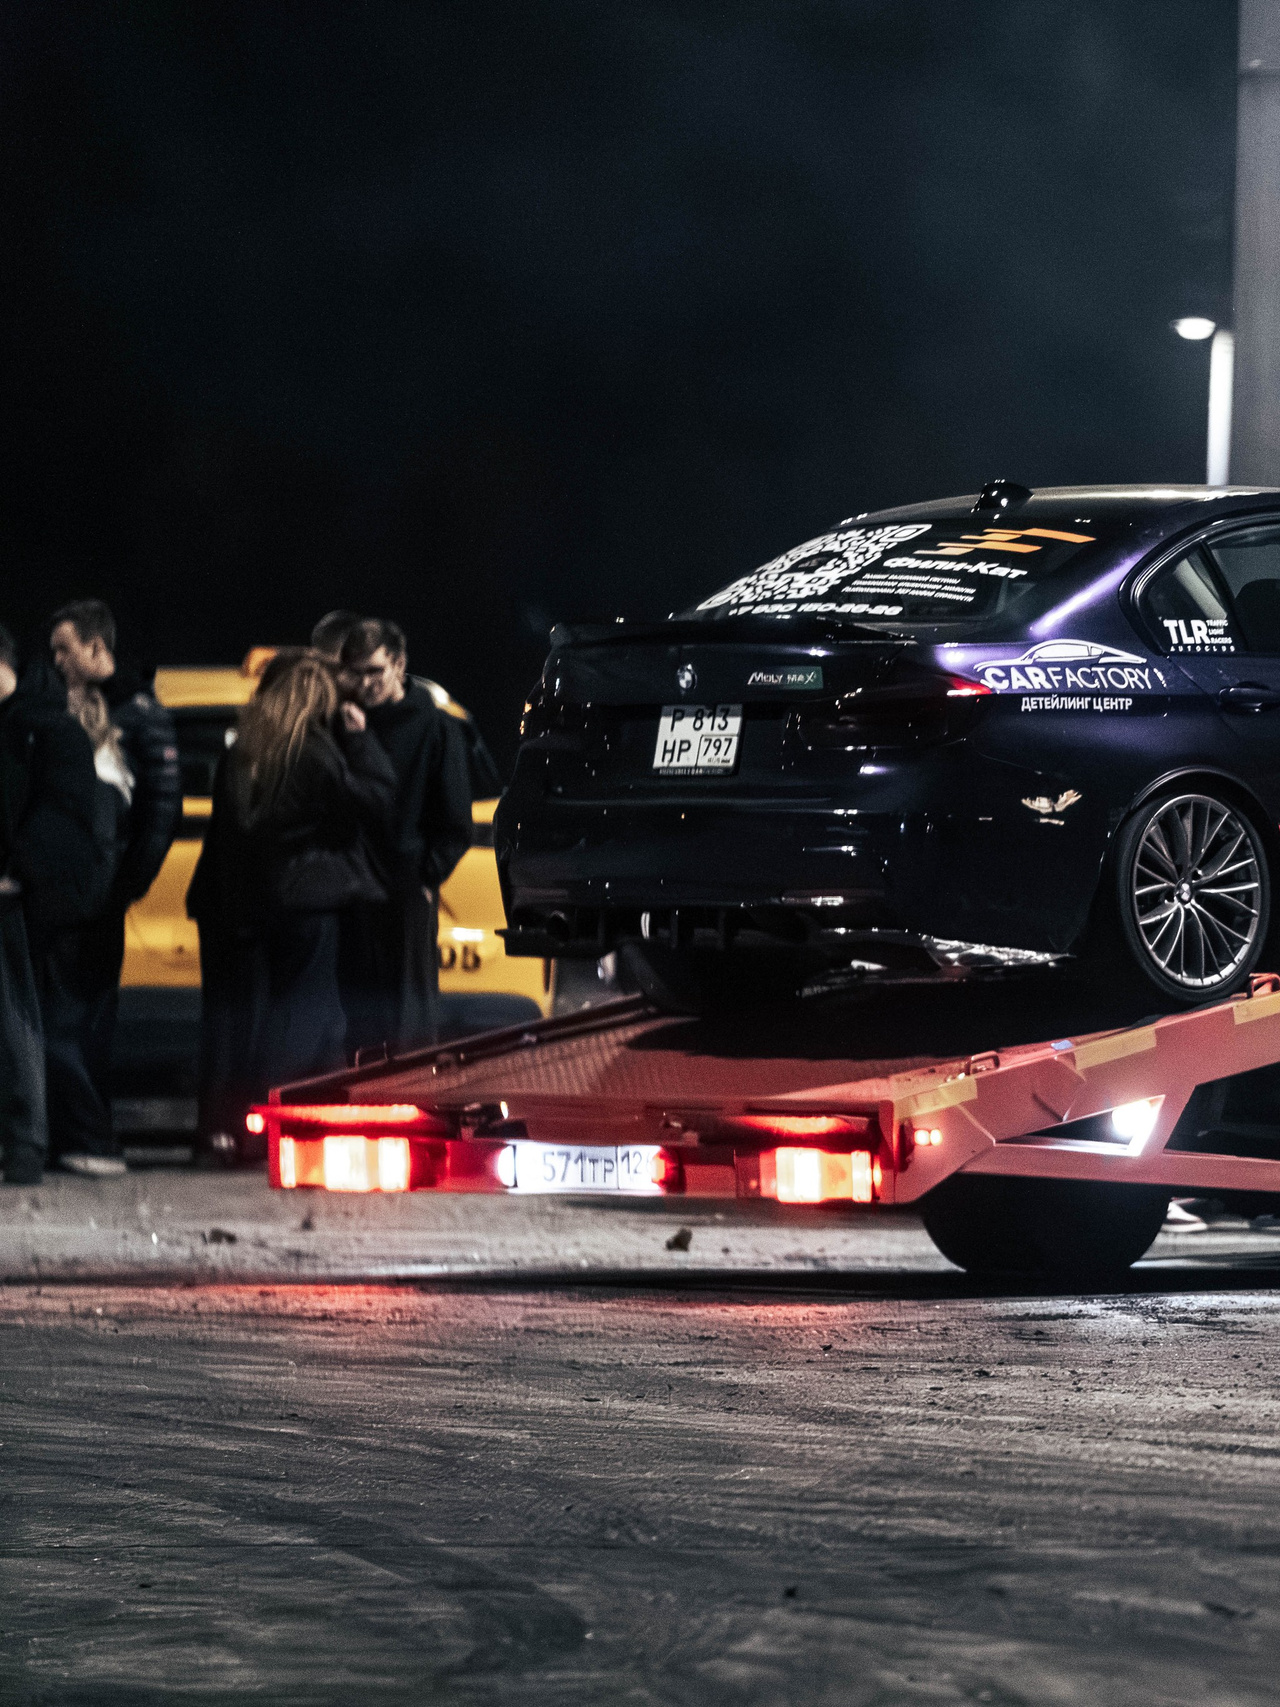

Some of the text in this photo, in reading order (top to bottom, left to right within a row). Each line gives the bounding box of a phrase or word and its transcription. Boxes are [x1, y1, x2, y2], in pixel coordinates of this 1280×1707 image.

[1163, 619, 1211, 645] TLR
[1169, 645, 1236, 653] AUTOCLUB
[1021, 694, 1133, 712] ДЕТЕЙЛИНГ ЦЕНТР
[692, 708, 731, 731] 813
[703, 737, 734, 756] 797
